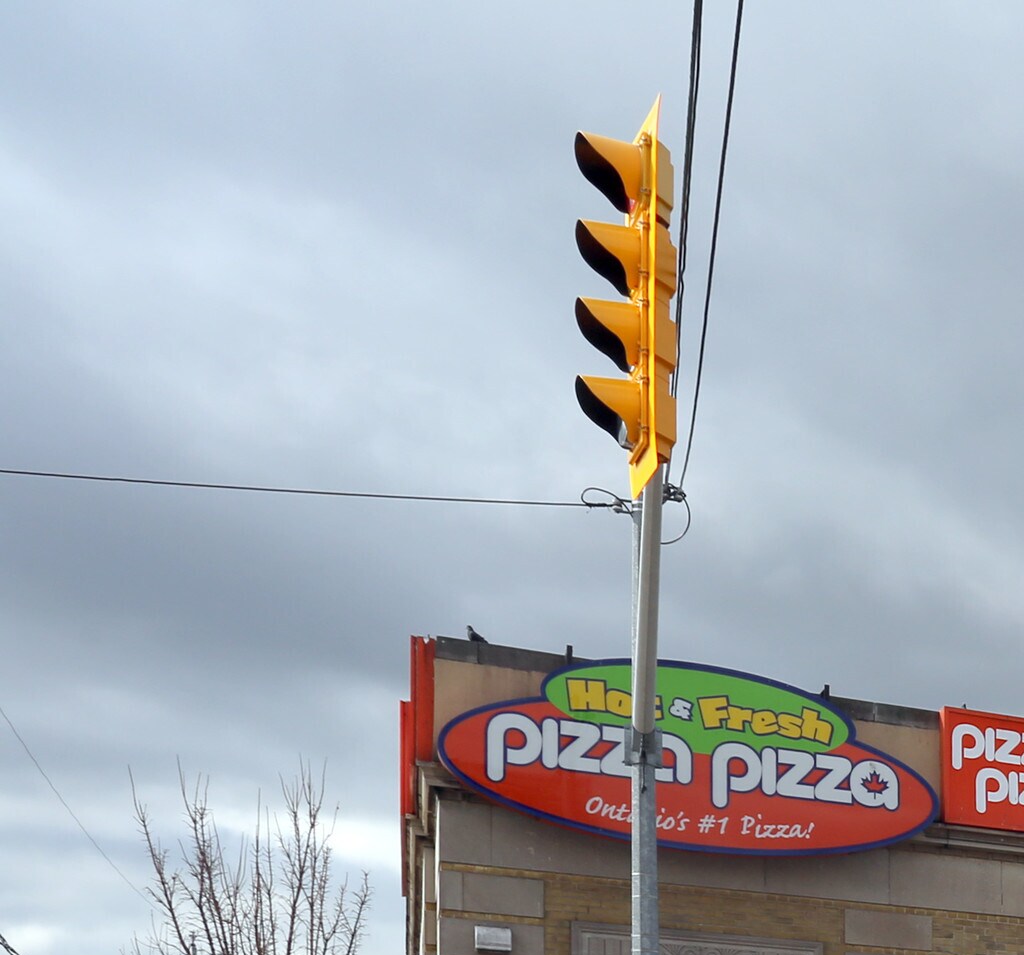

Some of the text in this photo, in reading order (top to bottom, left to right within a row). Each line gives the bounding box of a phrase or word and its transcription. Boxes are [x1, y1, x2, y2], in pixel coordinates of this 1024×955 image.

[668, 697, 694, 722] &
[696, 695, 834, 747] Fresh
[585, 796, 815, 839] Ontio's #1 Pizza!
